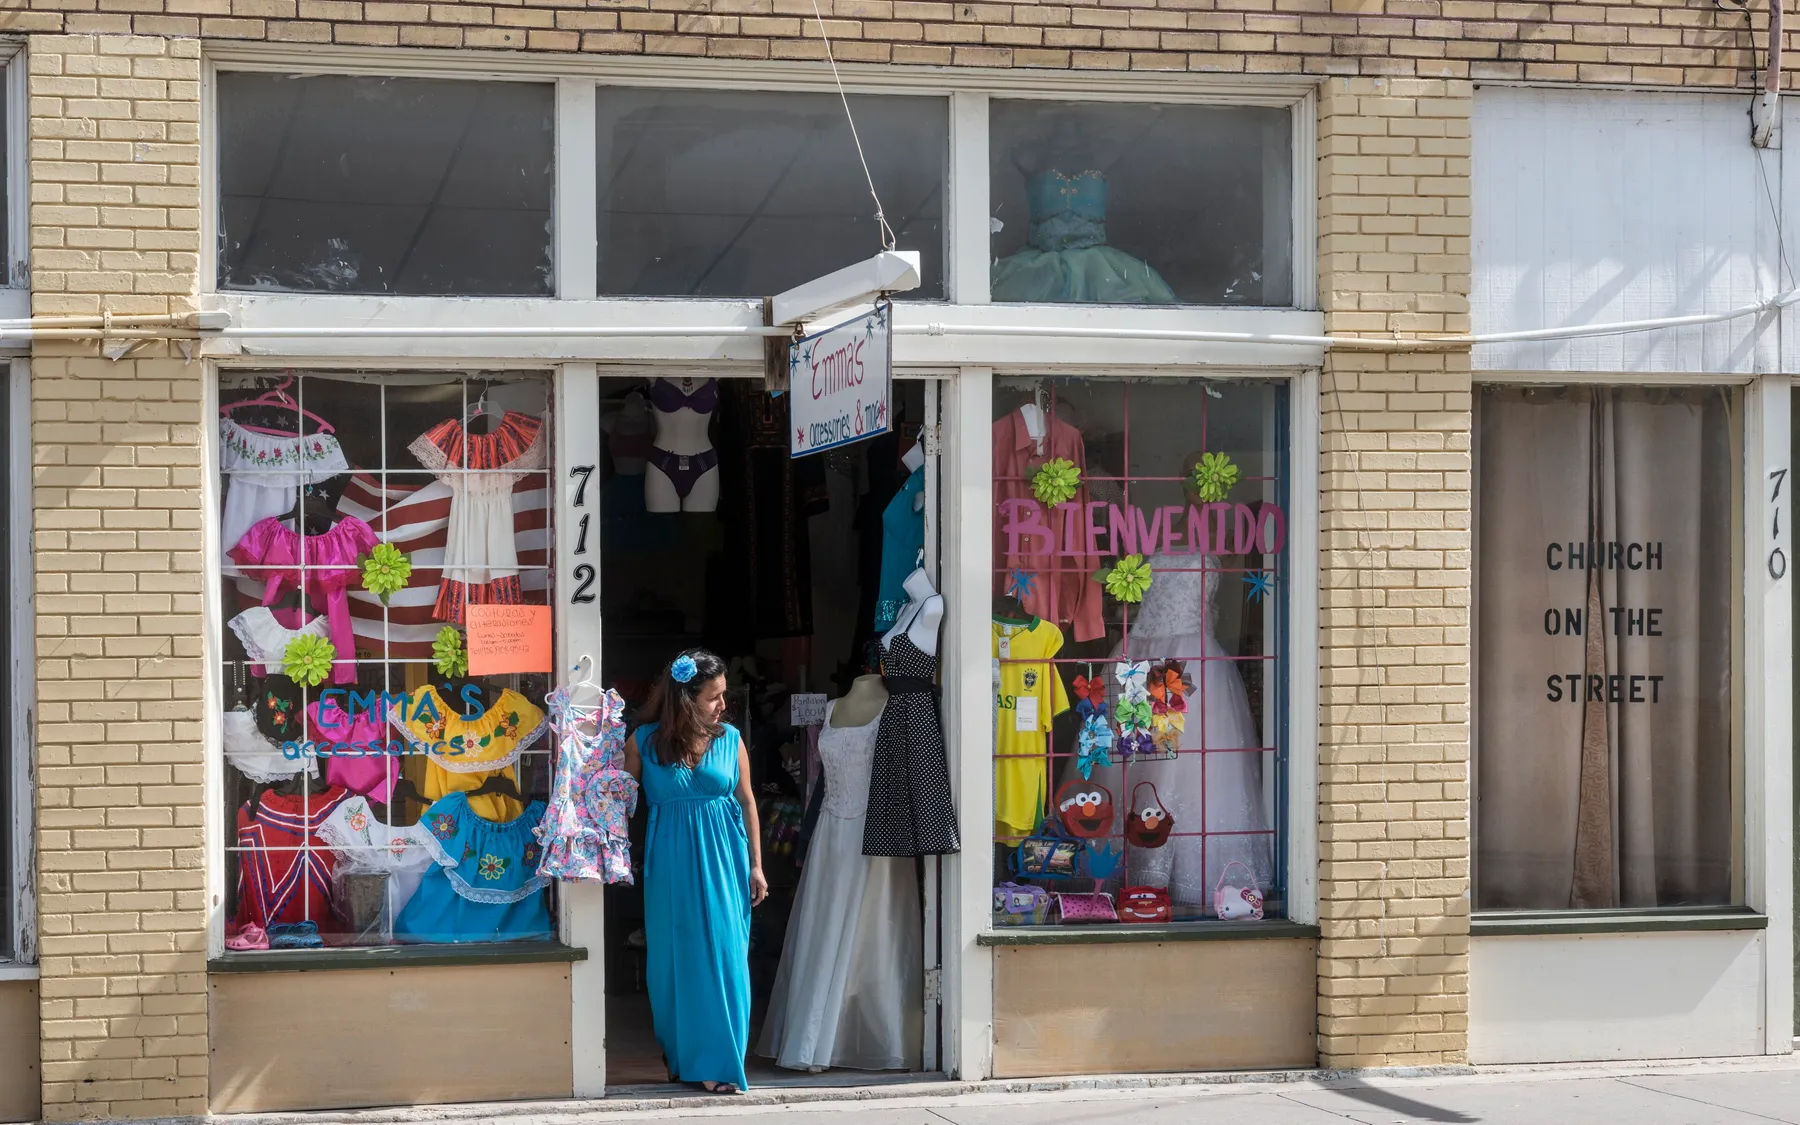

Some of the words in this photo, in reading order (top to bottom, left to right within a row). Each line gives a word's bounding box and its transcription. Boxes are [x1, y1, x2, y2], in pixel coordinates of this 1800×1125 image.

[811, 336, 865, 400] Emma's
[855, 399, 864, 436] &
[569, 464, 596, 605] 712
[998, 498, 1286, 556] BIENVENIDO
[1768, 468, 1788, 580] 710
[1546, 542, 1663, 571] CHURCH
[1544, 608, 1582, 636] ON
[1609, 607, 1663, 637] THE
[316, 683, 485, 728] EMMA'S
[1546, 674, 1664, 703] STREET
